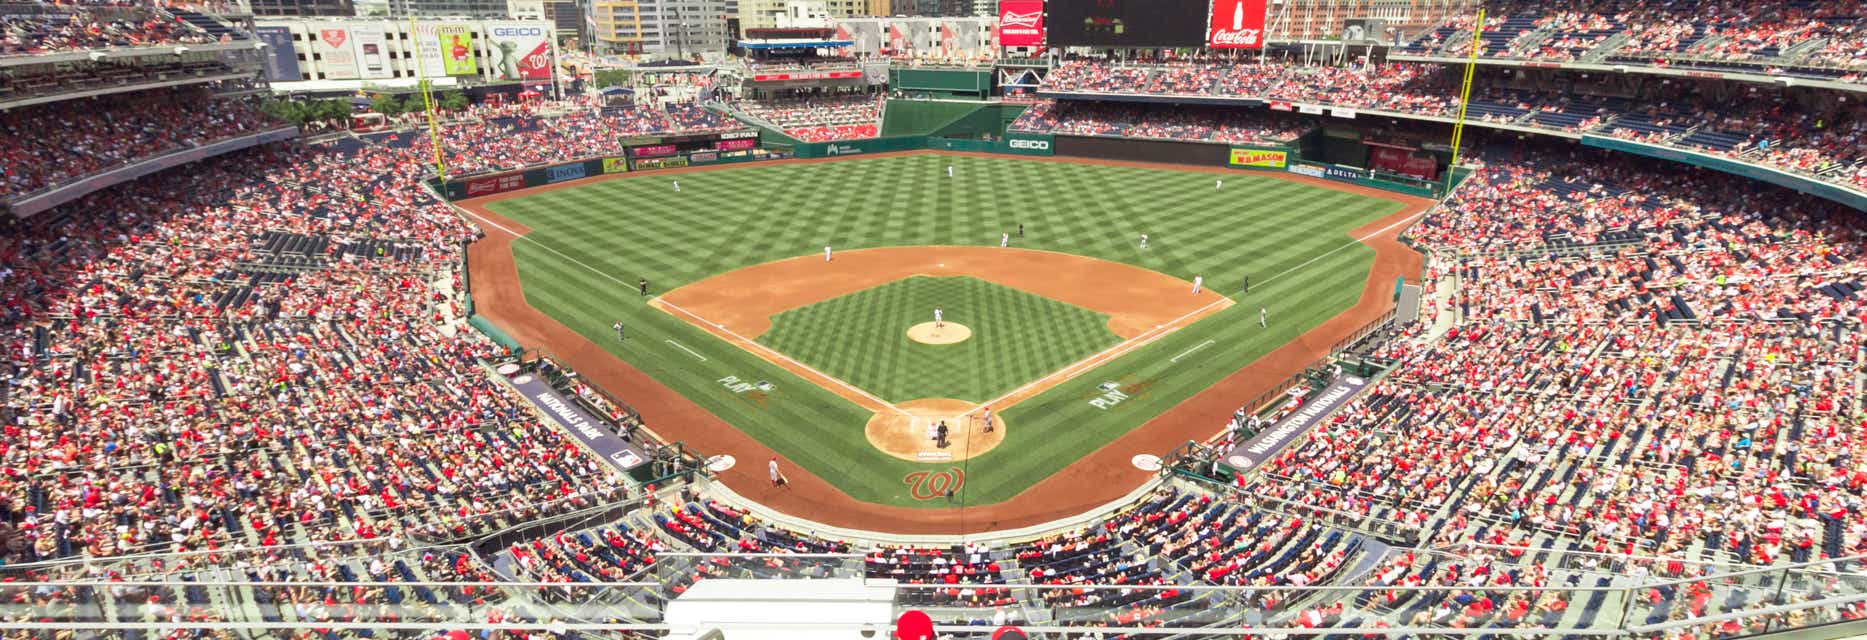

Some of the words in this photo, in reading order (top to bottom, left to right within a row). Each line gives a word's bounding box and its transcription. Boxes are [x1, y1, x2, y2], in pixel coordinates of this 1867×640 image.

[494, 27, 541, 37] GEICO
[1213, 28, 1260, 45] Coca-Cola
[1009, 139, 1049, 150] GEICO
[1253, 153, 1285, 161] MASON
[1333, 169, 1357, 178] DELTA
[536, 392, 584, 424] NATIONALS
[574, 421, 604, 440] PARK
[1248, 413, 1312, 454] WASHINGTON
[1302, 385, 1351, 416] NATIONALS
